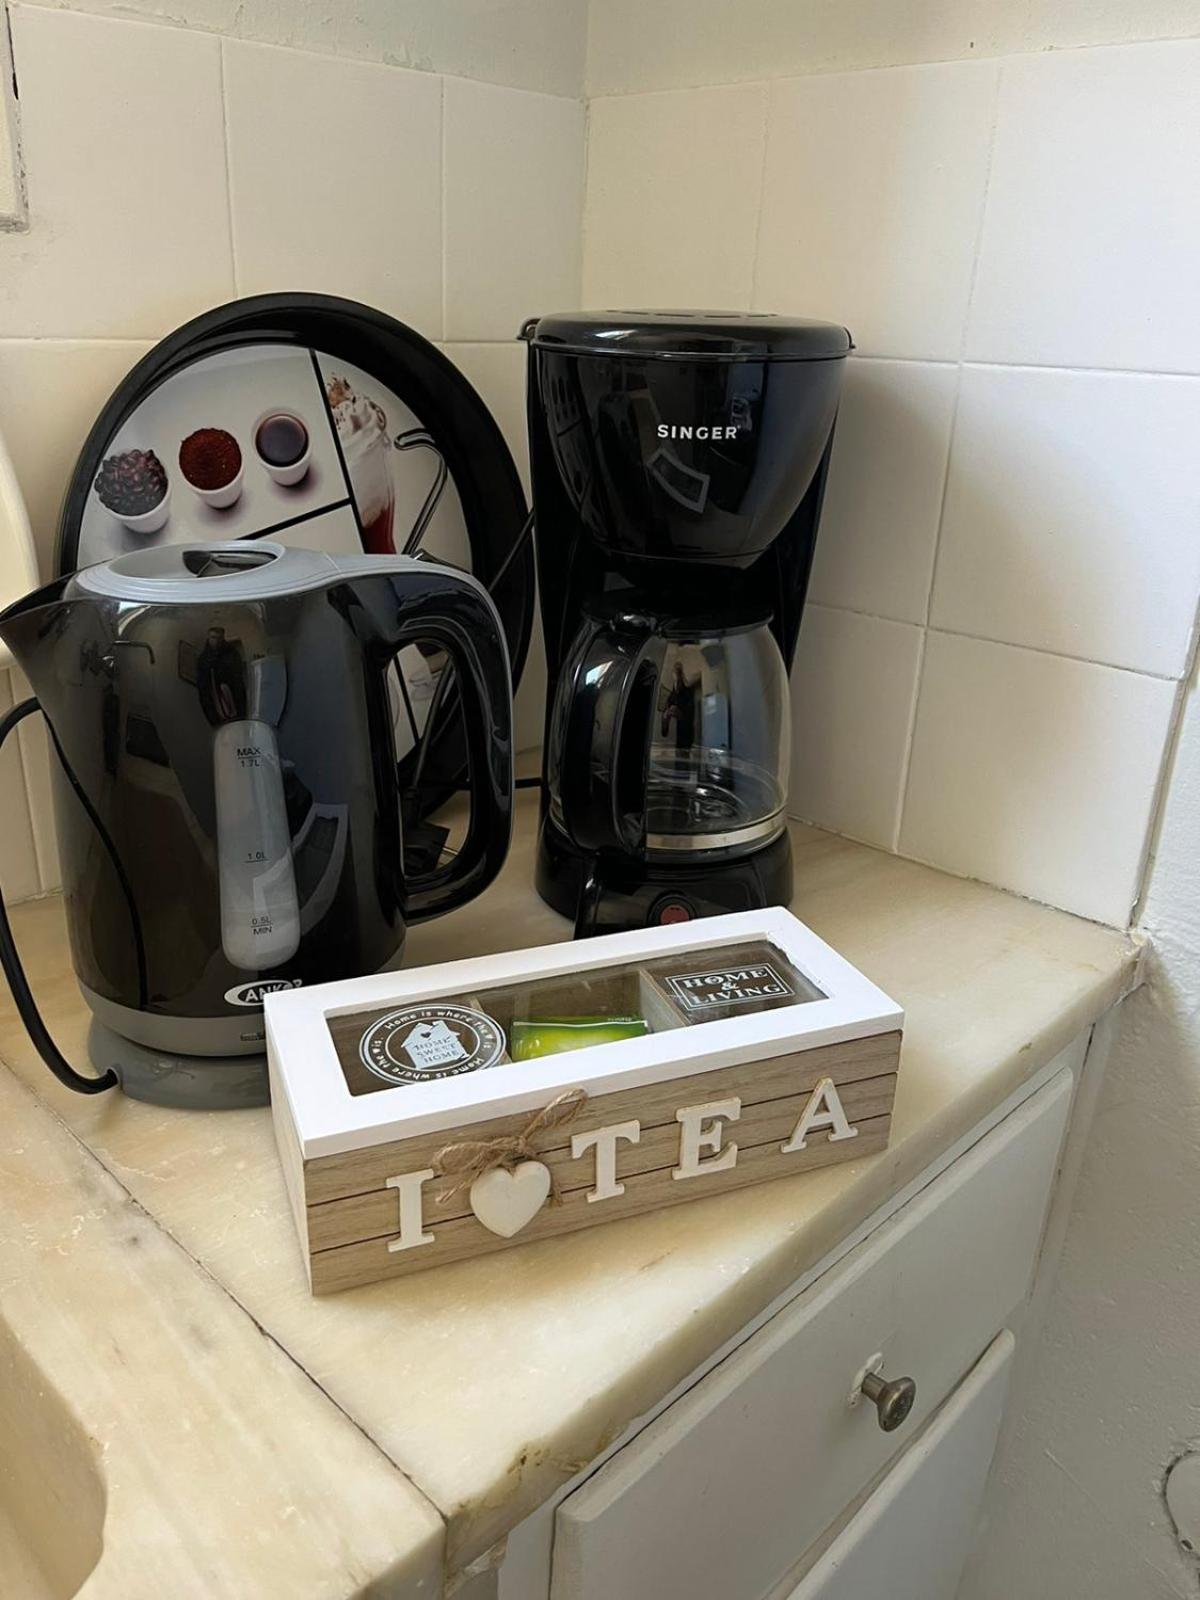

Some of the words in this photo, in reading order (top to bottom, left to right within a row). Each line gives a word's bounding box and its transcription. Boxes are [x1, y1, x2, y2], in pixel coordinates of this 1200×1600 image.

[657, 424, 738, 440] SINGER
[237, 747, 261, 756] MAX
[253, 926, 273, 936] MIN
[682, 969, 768, 988] HOME
[720, 981, 740, 991] &
[692, 984, 781, 1004] LIVING
[384, 1014, 417, 1030] Home
[421, 1011, 432, 1019] is
[437, 1010, 473, 1022] where
[417, 1043, 456, 1057] SWEET
[424, 1051, 460, 1063] HOME
[392, 1067, 430, 1080] where
[451, 1058, 484, 1075] Home
[386, 1168, 435, 1253] I
